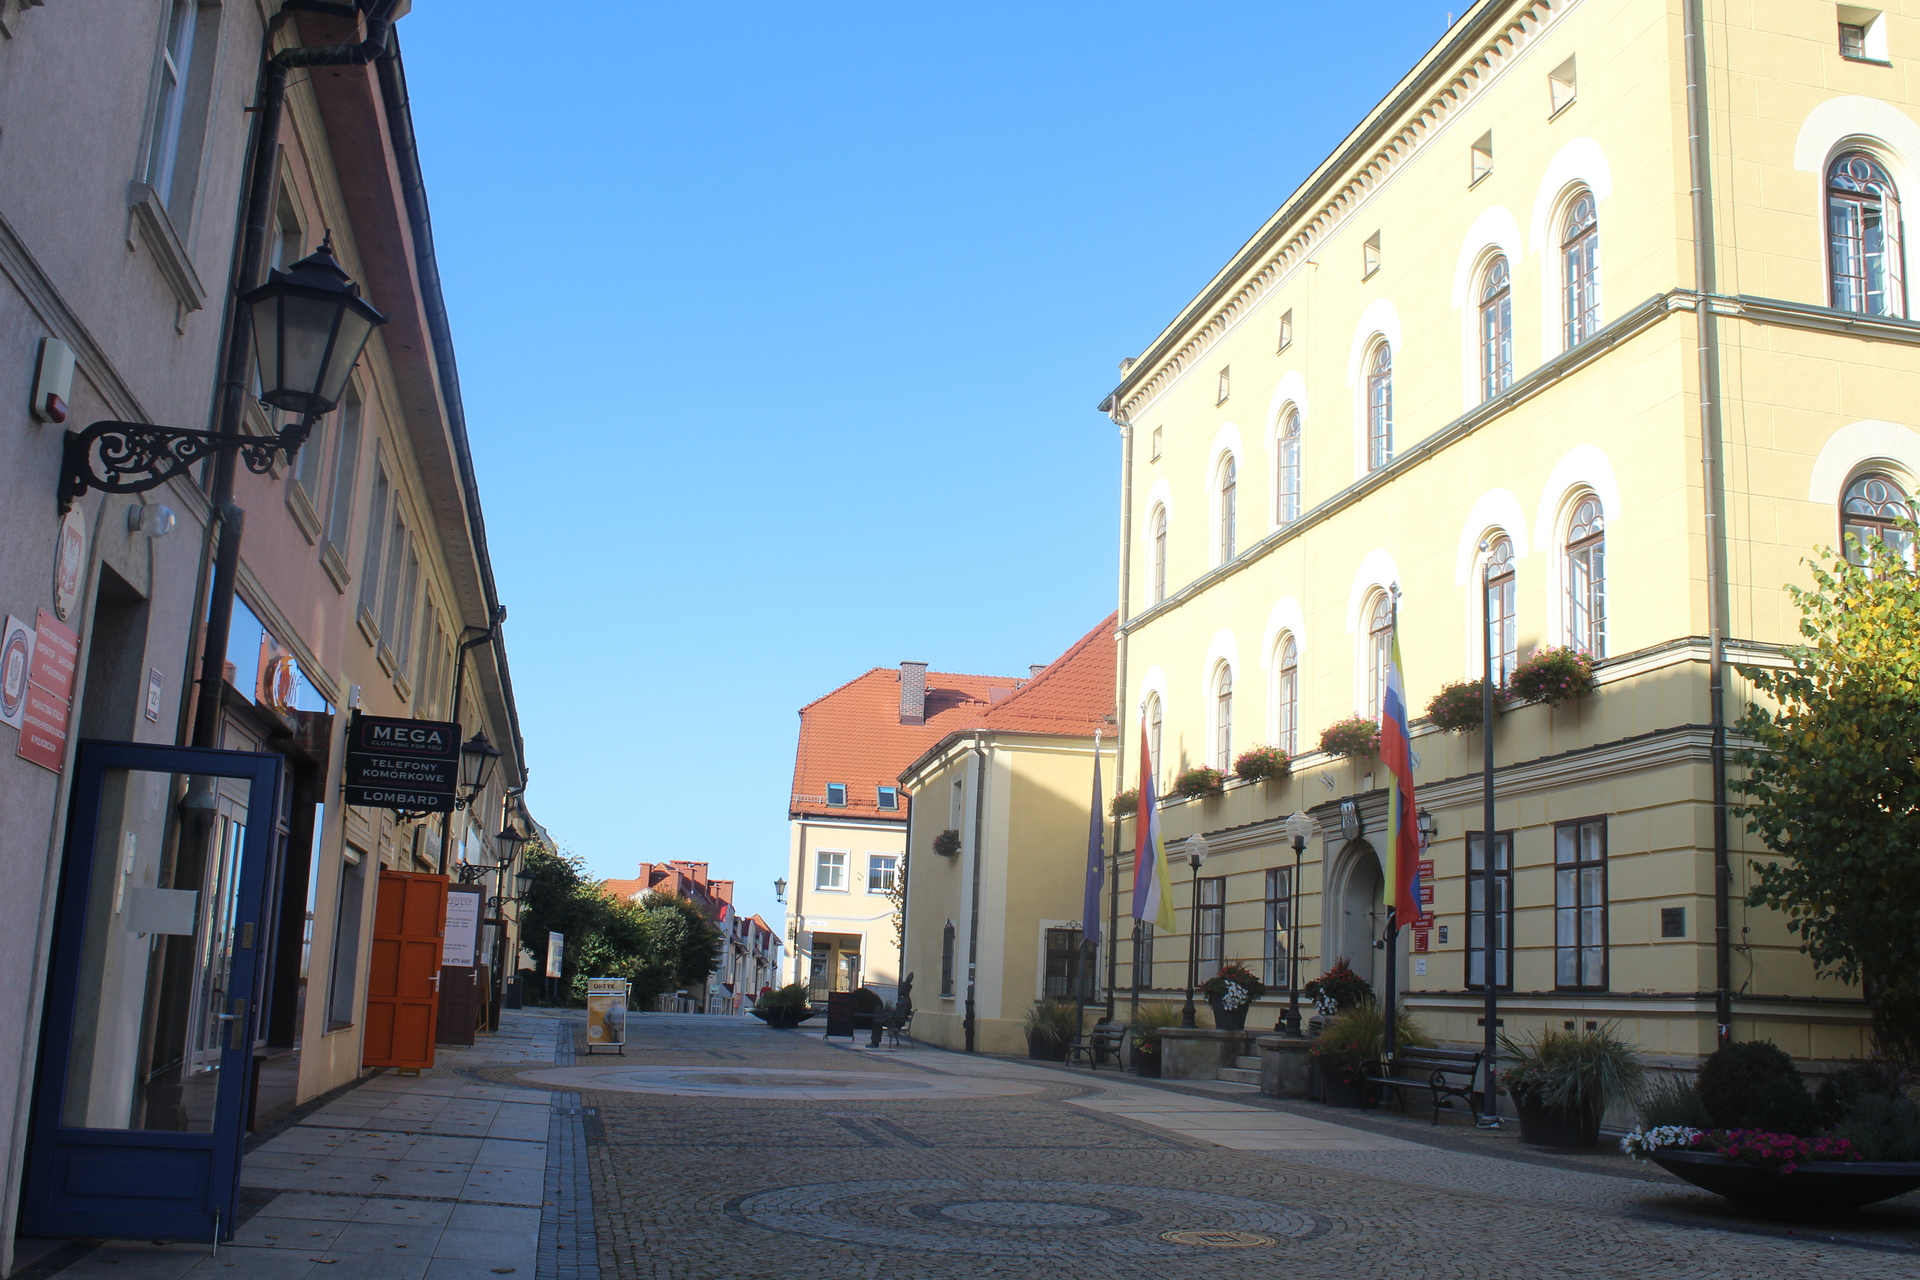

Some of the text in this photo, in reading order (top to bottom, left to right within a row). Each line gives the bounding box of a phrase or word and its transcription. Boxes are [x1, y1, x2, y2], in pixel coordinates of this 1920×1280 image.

[373, 726, 443, 744] MEGA
[371, 740, 409, 748] CLOTHING
[371, 759, 438, 772] TELEFONY
[362, 768, 445, 783] KOMÓRKOWE
[363, 791, 439, 806] LOMBARD
